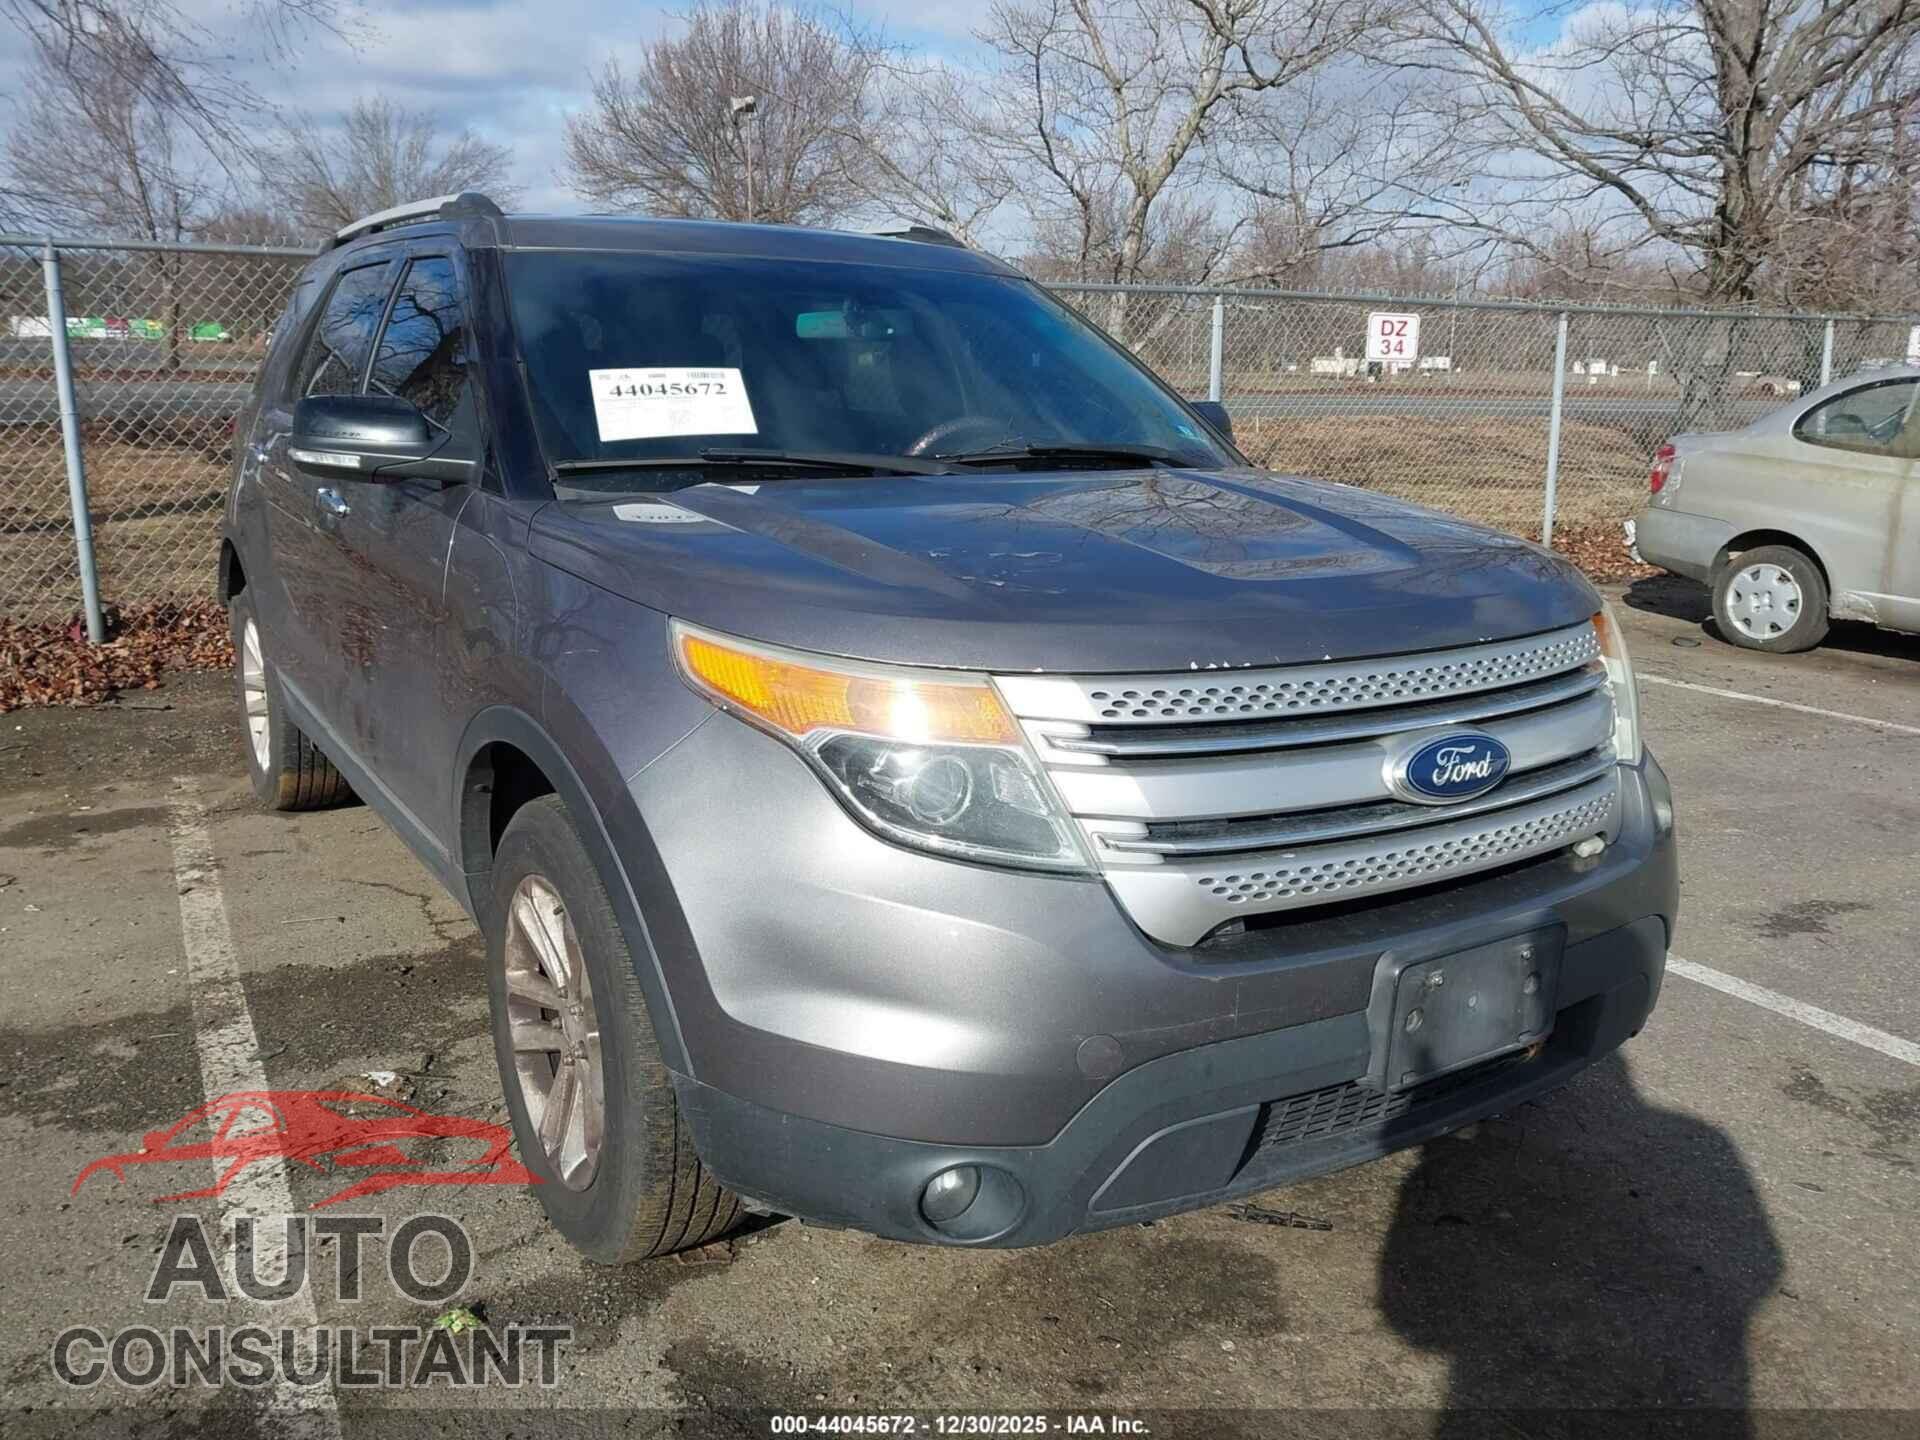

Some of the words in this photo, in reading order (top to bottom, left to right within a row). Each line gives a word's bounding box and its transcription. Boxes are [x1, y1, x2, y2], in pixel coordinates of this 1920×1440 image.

[1381, 320, 1408, 337] DZ
[1380, 339, 1404, 355] 34
[609, 383, 727, 397] 44045672
[1432, 745, 1494, 786] Ford
